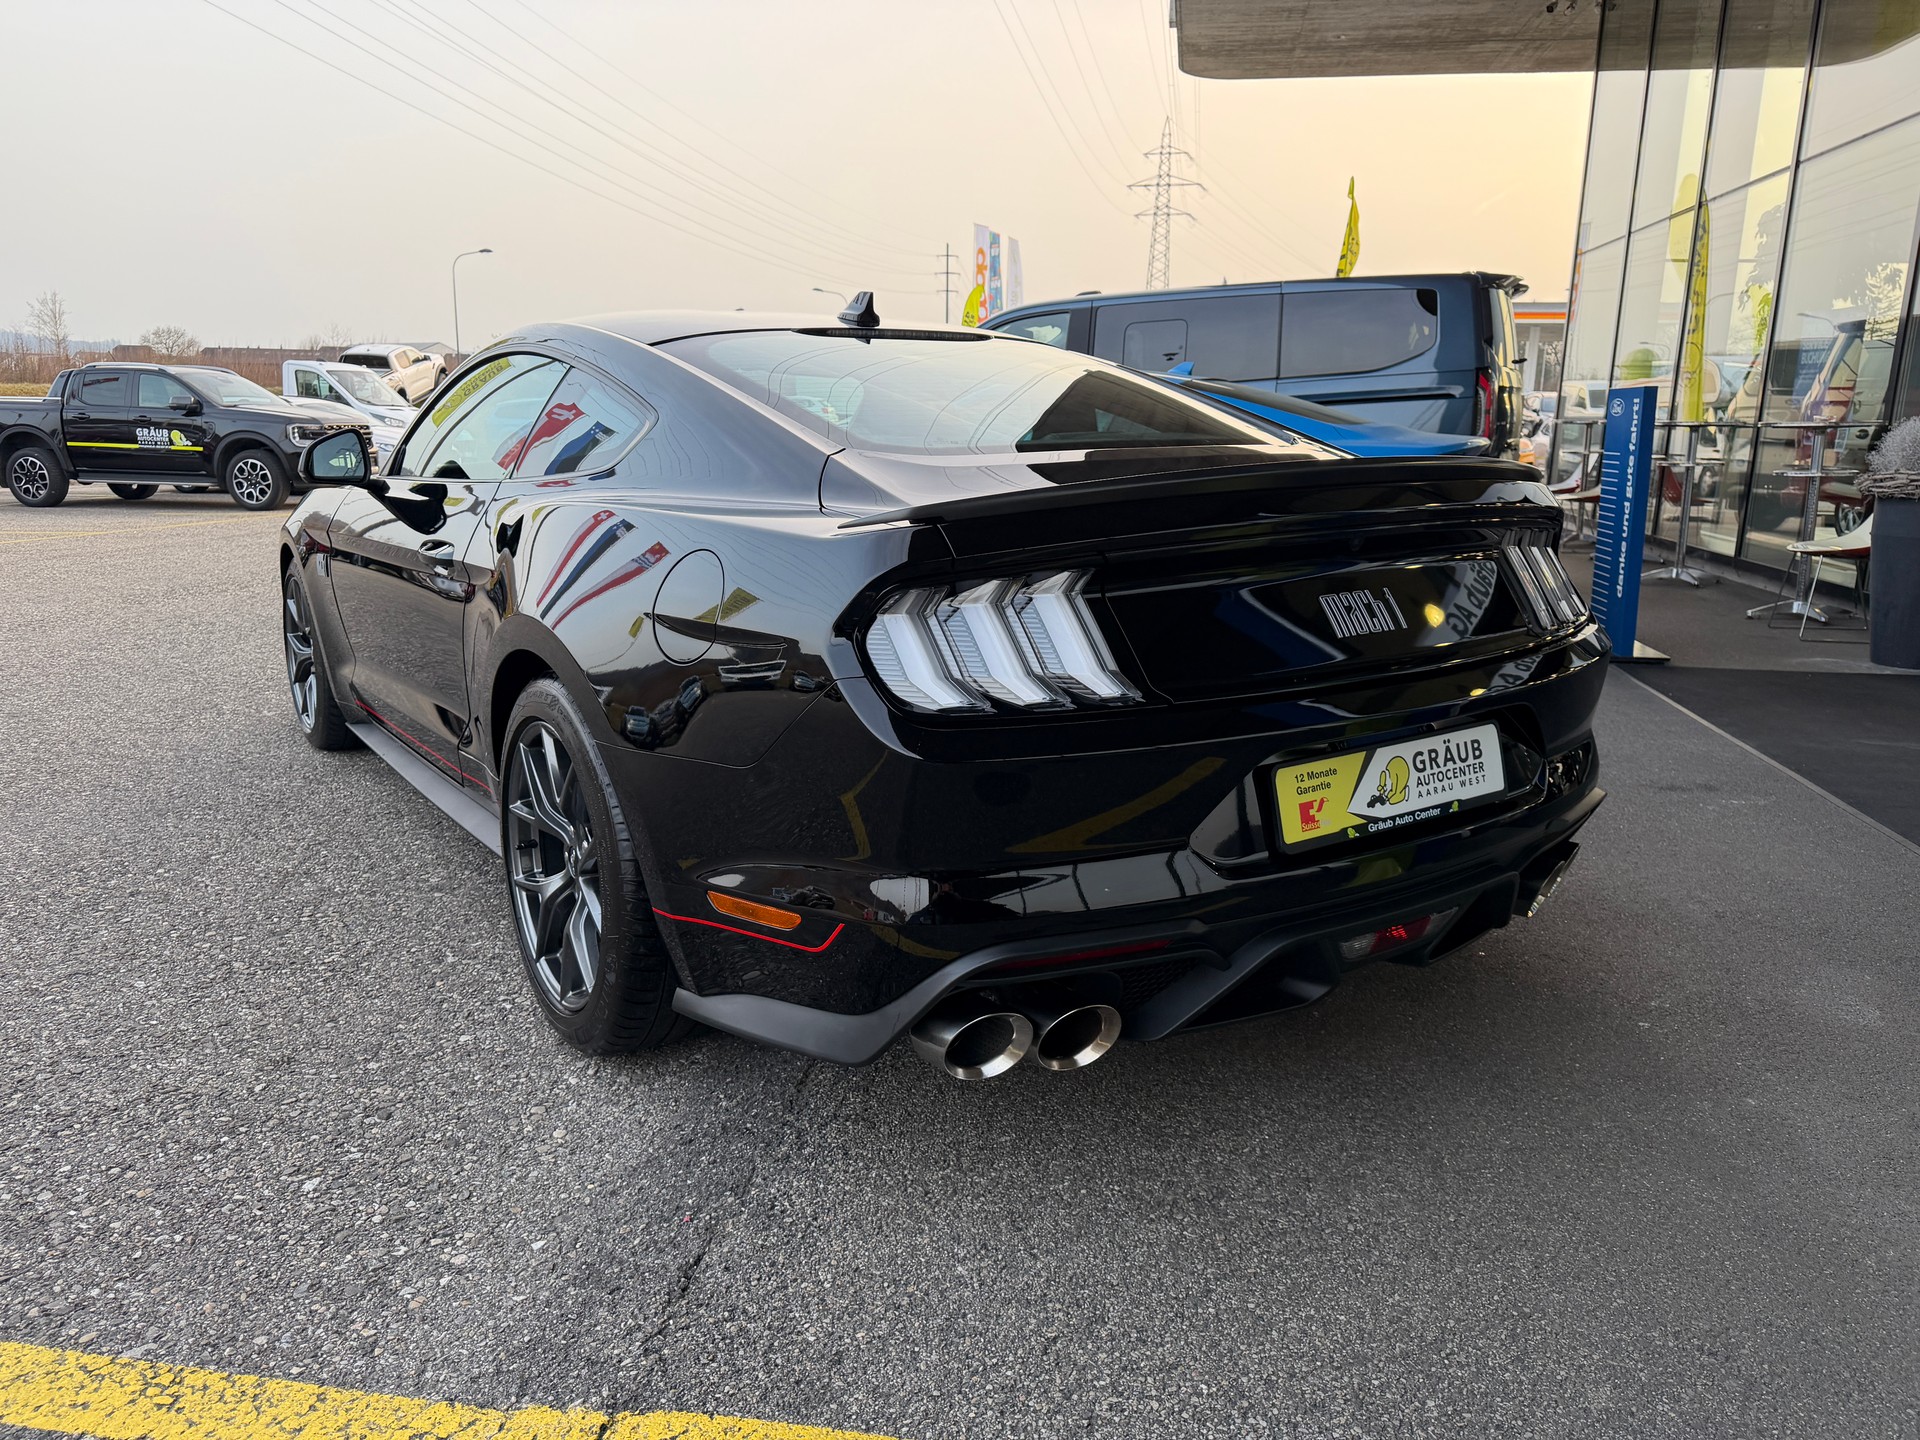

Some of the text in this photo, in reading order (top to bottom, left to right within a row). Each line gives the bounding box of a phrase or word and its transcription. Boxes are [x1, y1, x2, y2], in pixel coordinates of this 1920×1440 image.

[136, 427, 168, 437] GRÄUB
[1626, 455, 1635, 499] gute
[1622, 501, 1631, 538] und
[1616, 541, 1627, 598] danke
[1412, 738, 1483, 773] GRÄUB
[1294, 767, 1337, 784] 12 Monate
[1416, 761, 1485, 788] AUTOCENTER
[1417, 774, 1487, 799] AARAU WEST
[1296, 780, 1332, 796] Garantie
[1368, 807, 1441, 832] Gräub Auto Center
